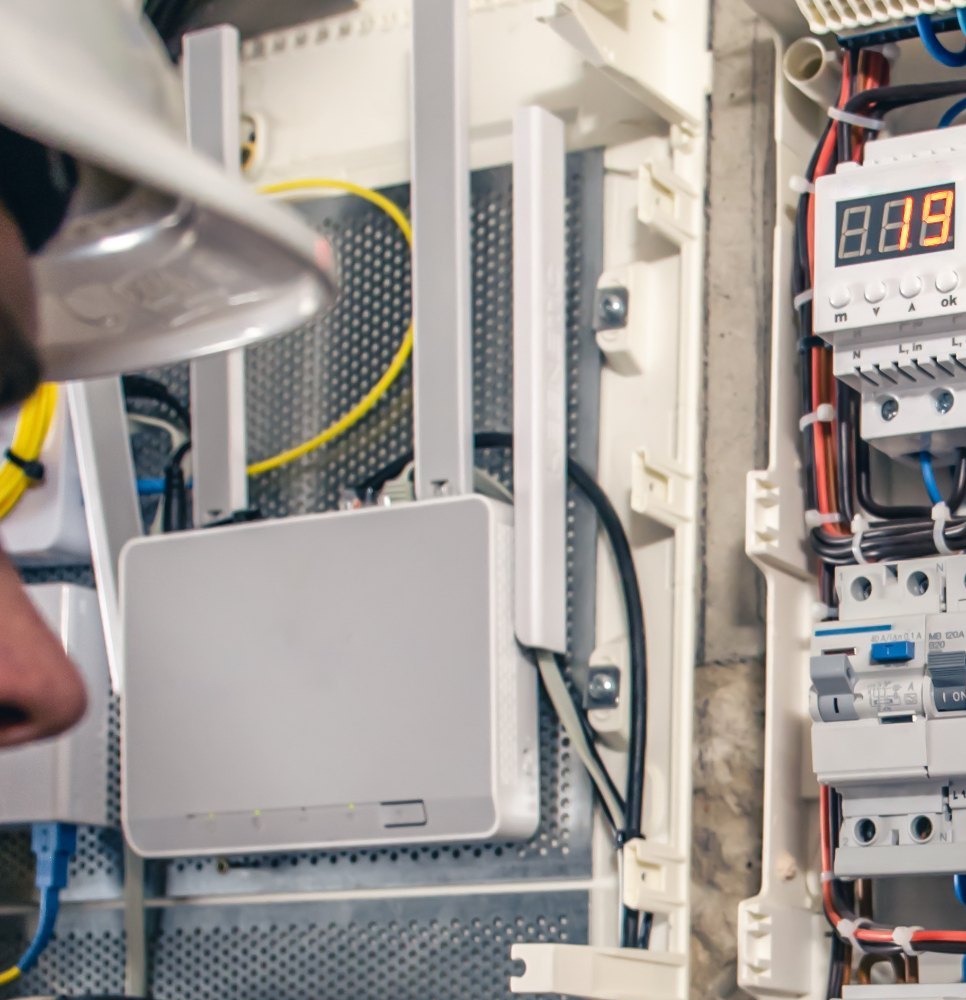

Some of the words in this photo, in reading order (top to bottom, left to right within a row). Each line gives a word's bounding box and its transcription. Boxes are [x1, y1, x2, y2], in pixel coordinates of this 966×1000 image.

[898, 189, 954, 251] 19
[940, 296, 958, 308] ok
[834, 312, 848, 323] m
[912, 343, 923, 351] in
[853, 351, 861, 359] N
[936, 562, 944, 573] N
